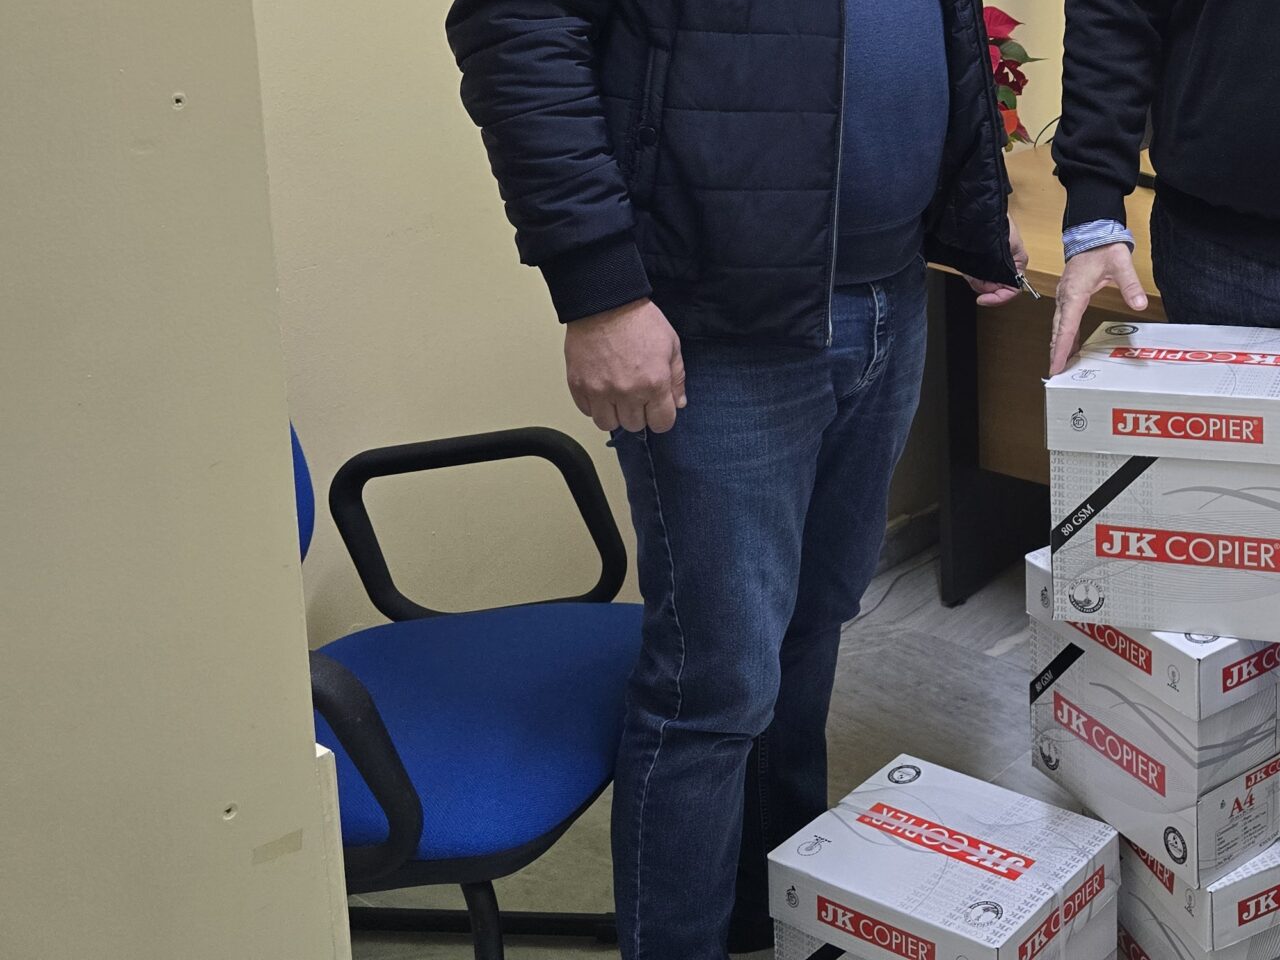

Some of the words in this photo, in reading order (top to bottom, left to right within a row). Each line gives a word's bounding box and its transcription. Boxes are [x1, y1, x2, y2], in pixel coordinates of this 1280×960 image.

[1125, 349, 1237, 362] COPIER
[1117, 413, 1162, 435] JK
[1061, 523, 1074, 537] 80
[1072, 504, 1096, 526] GSM
[1102, 530, 1158, 558] JK
[1227, 656, 1259, 687] JK
[1057, 700, 1088, 740] JK
[1248, 768, 1266, 787] JK
[1228, 788, 1255, 819] A4
[966, 843, 1026, 874] JK
[821, 903, 856, 934] JK
[1242, 890, 1278, 921] JK
